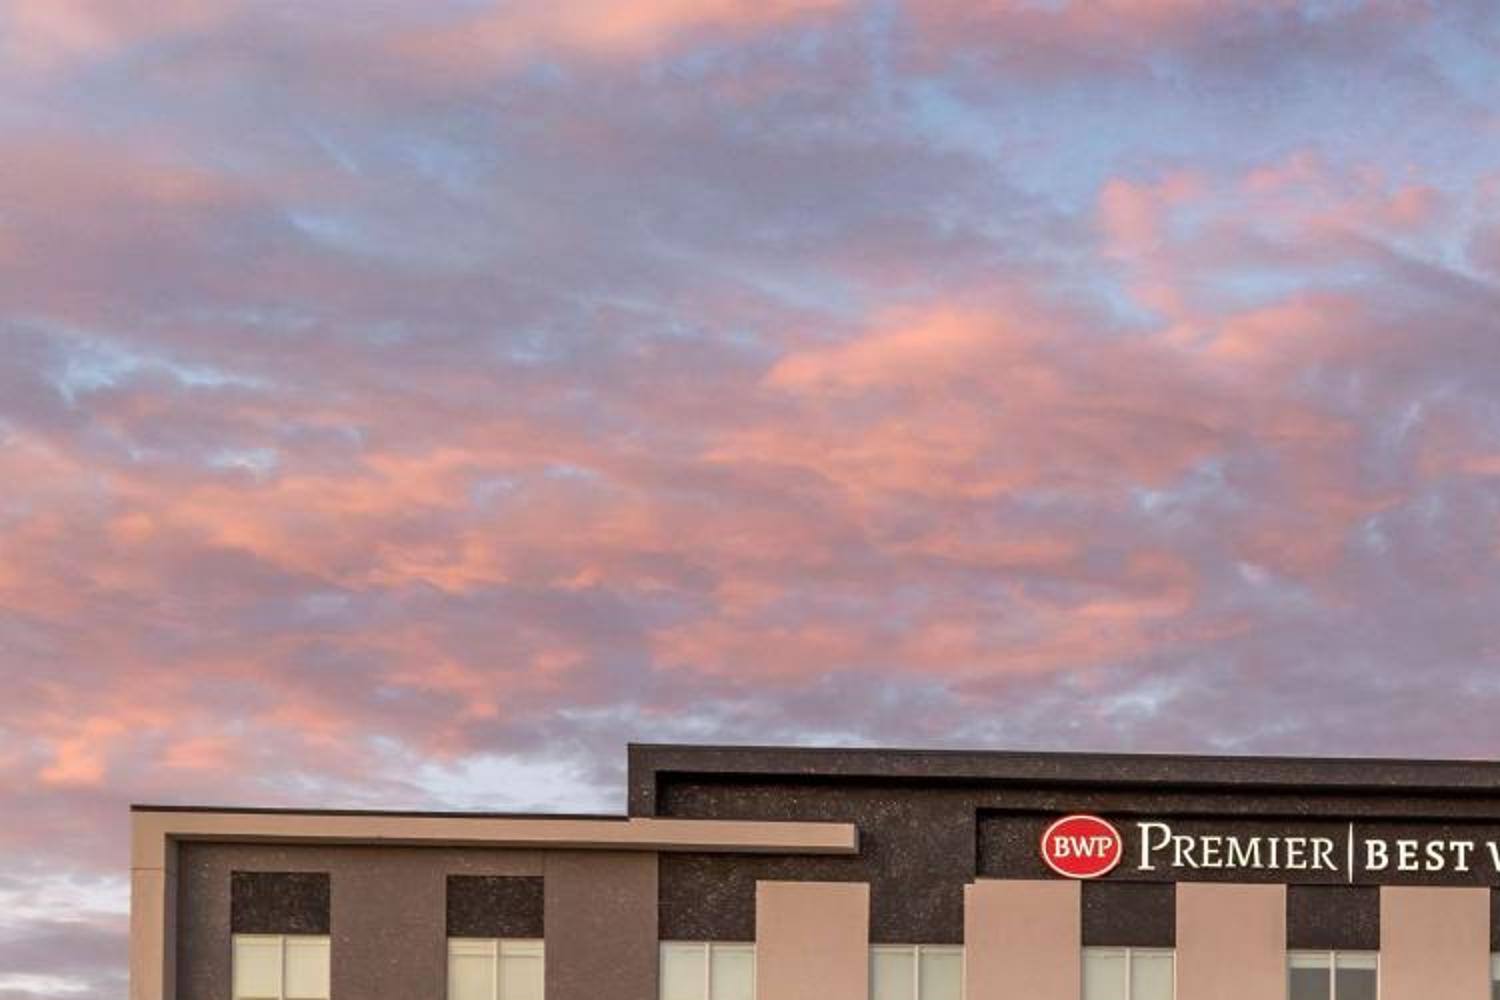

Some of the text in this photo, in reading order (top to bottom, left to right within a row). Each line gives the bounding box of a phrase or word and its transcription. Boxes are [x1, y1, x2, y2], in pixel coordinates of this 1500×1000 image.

[1053, 835, 1113, 858] BWP
[1136, 822, 1338, 872] PREMIER
[1365, 839, 1475, 872] BEST
